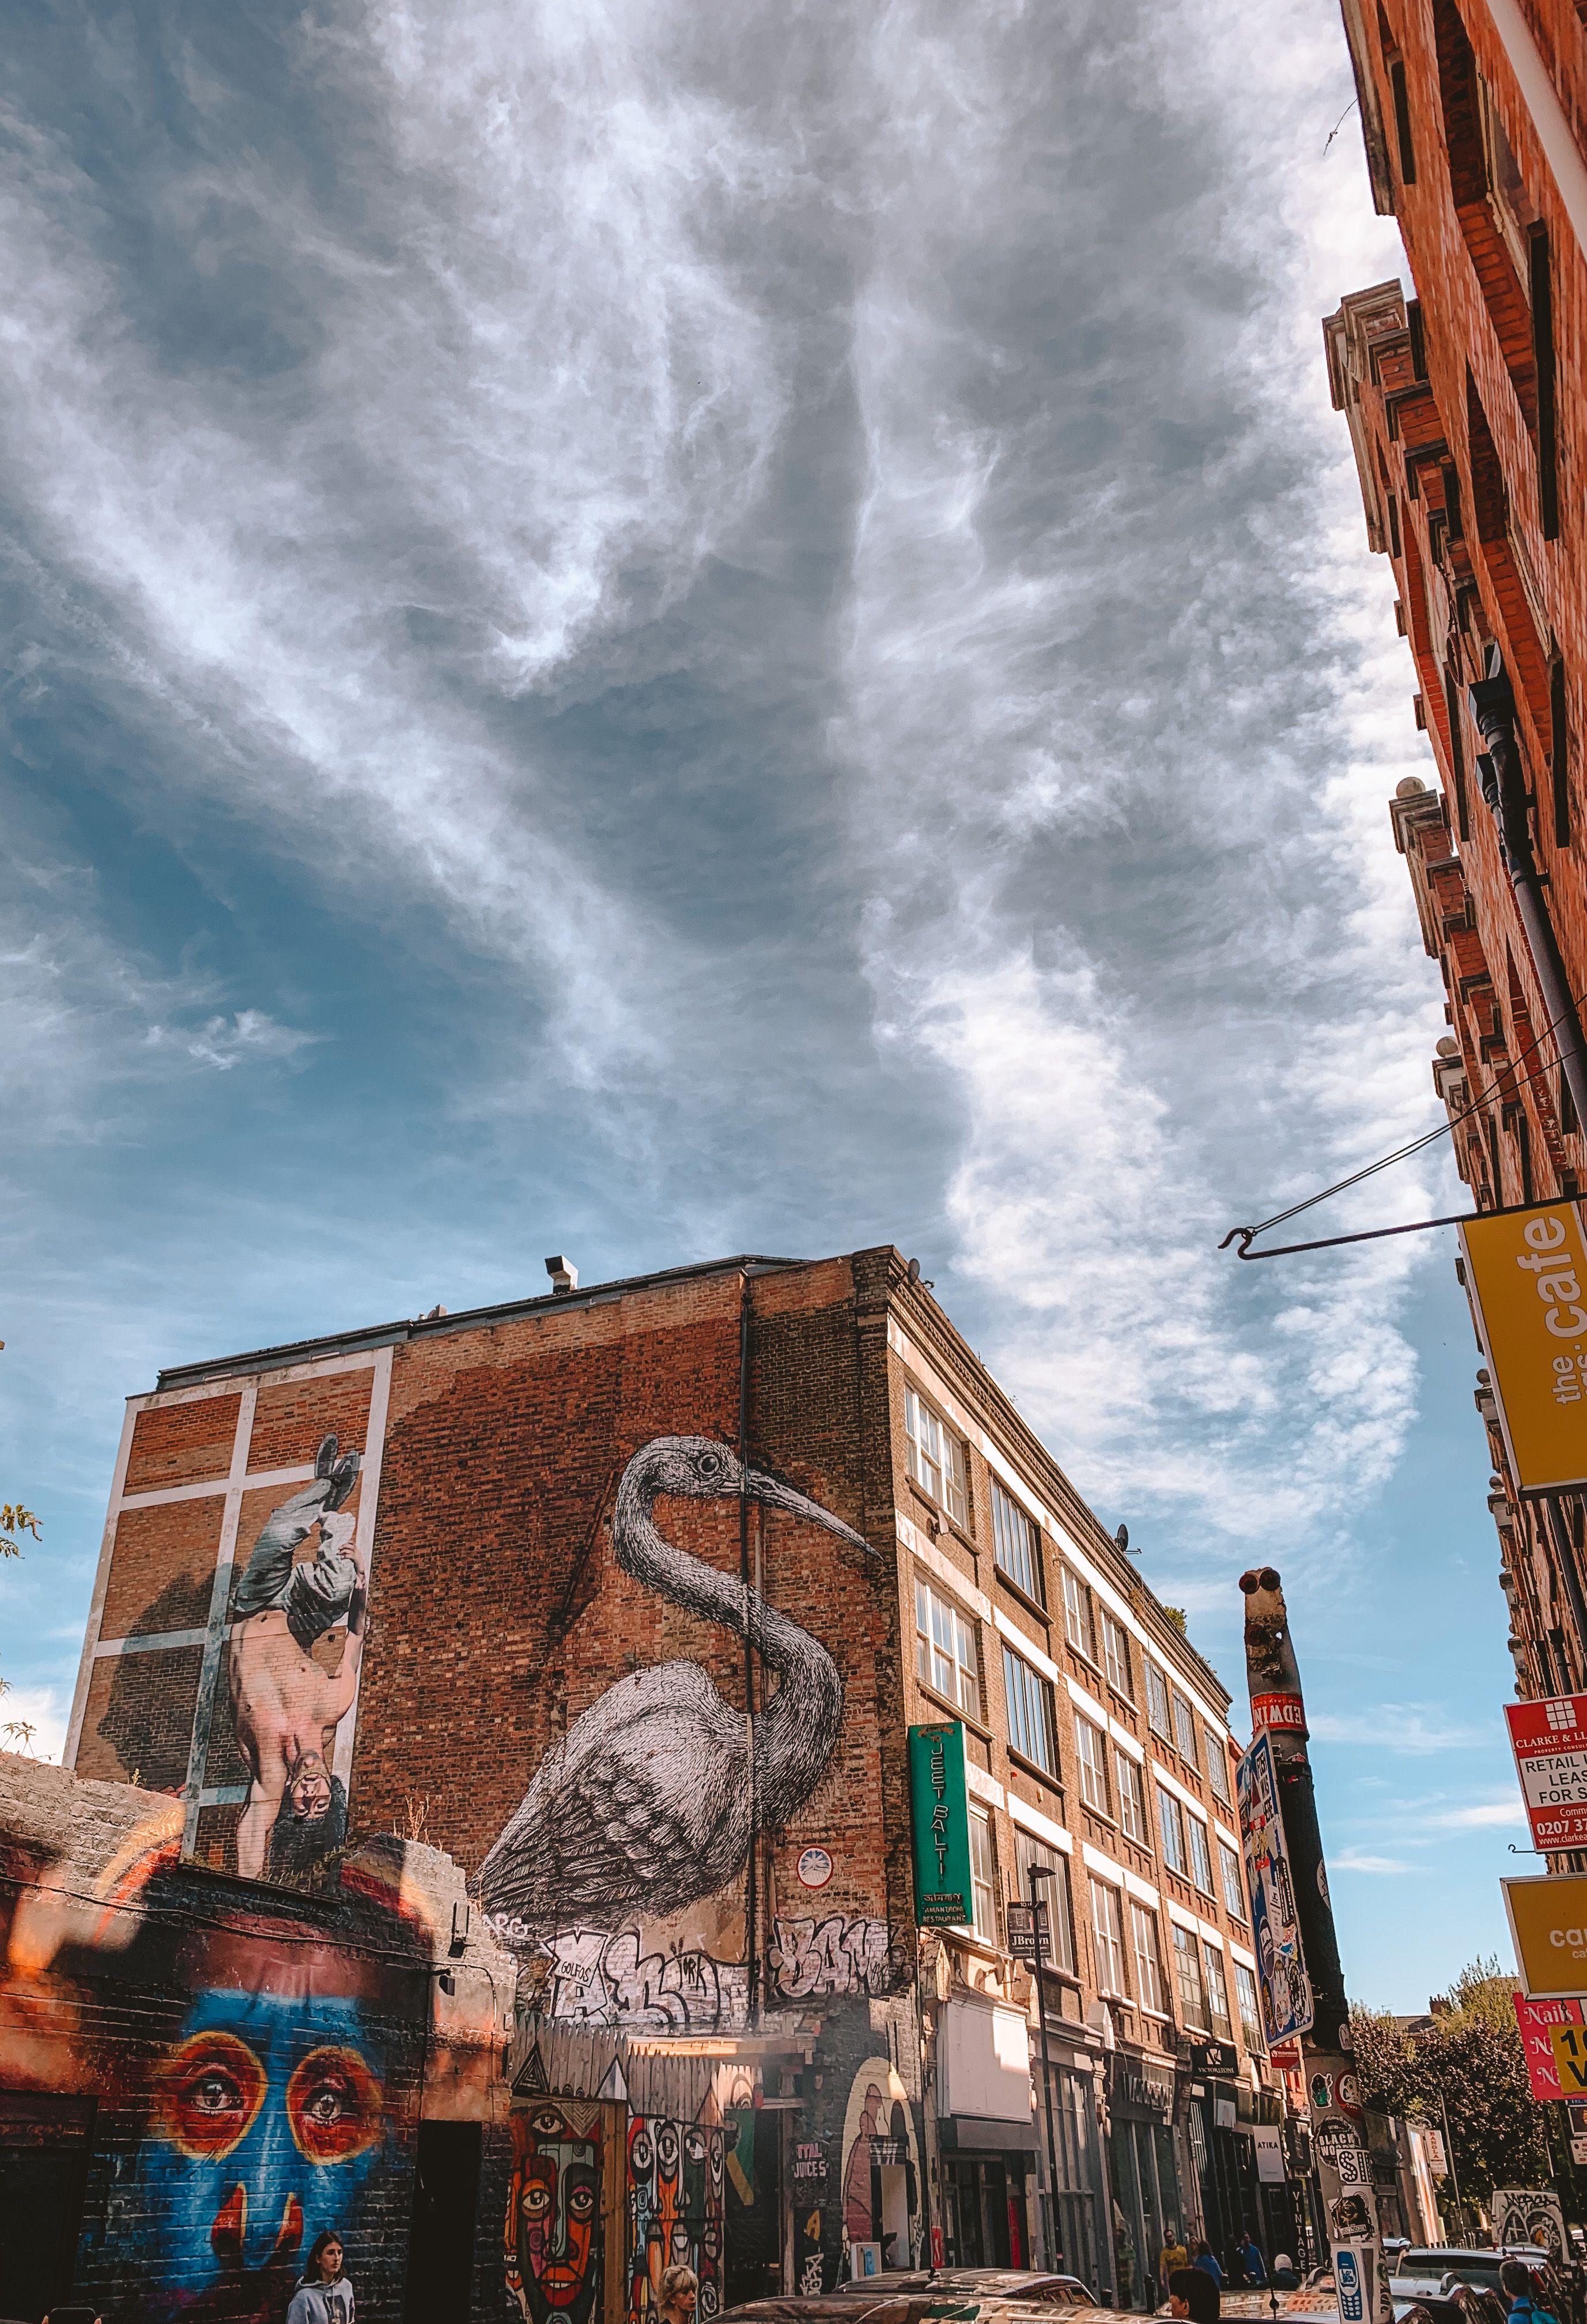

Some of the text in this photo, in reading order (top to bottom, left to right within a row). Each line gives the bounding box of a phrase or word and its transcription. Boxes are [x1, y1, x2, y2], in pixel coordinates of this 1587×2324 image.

[1517, 1216, 1587, 1338] cafe
[1552, 1356, 1581, 1405] the
[1254, 1704, 1302, 1727] EDWIN
[1516, 1735, 1560, 1748] CLARKE
[1562, 1734, 1571, 1742] &
[931, 1743, 944, 1799] JEET
[1525, 1756, 1580, 1773] RETAIL
[1539, 1789, 1573, 1804] FOR
[1536, 1820, 1569, 1835] 0207
[931, 1805, 948, 1878] BALTI
[561, 1961, 591, 1982] GOLFOS
[1523, 2004, 1574, 2025] Nails
[1257, 2141, 1279, 2149] ATIKA
[1319, 2133, 1355, 2146] BLACK
[1430, 2131, 1439, 2159] BANGLA
[794, 2161, 827, 2178] JUICES
[1293, 2191, 1306, 2270] VINTAGE
